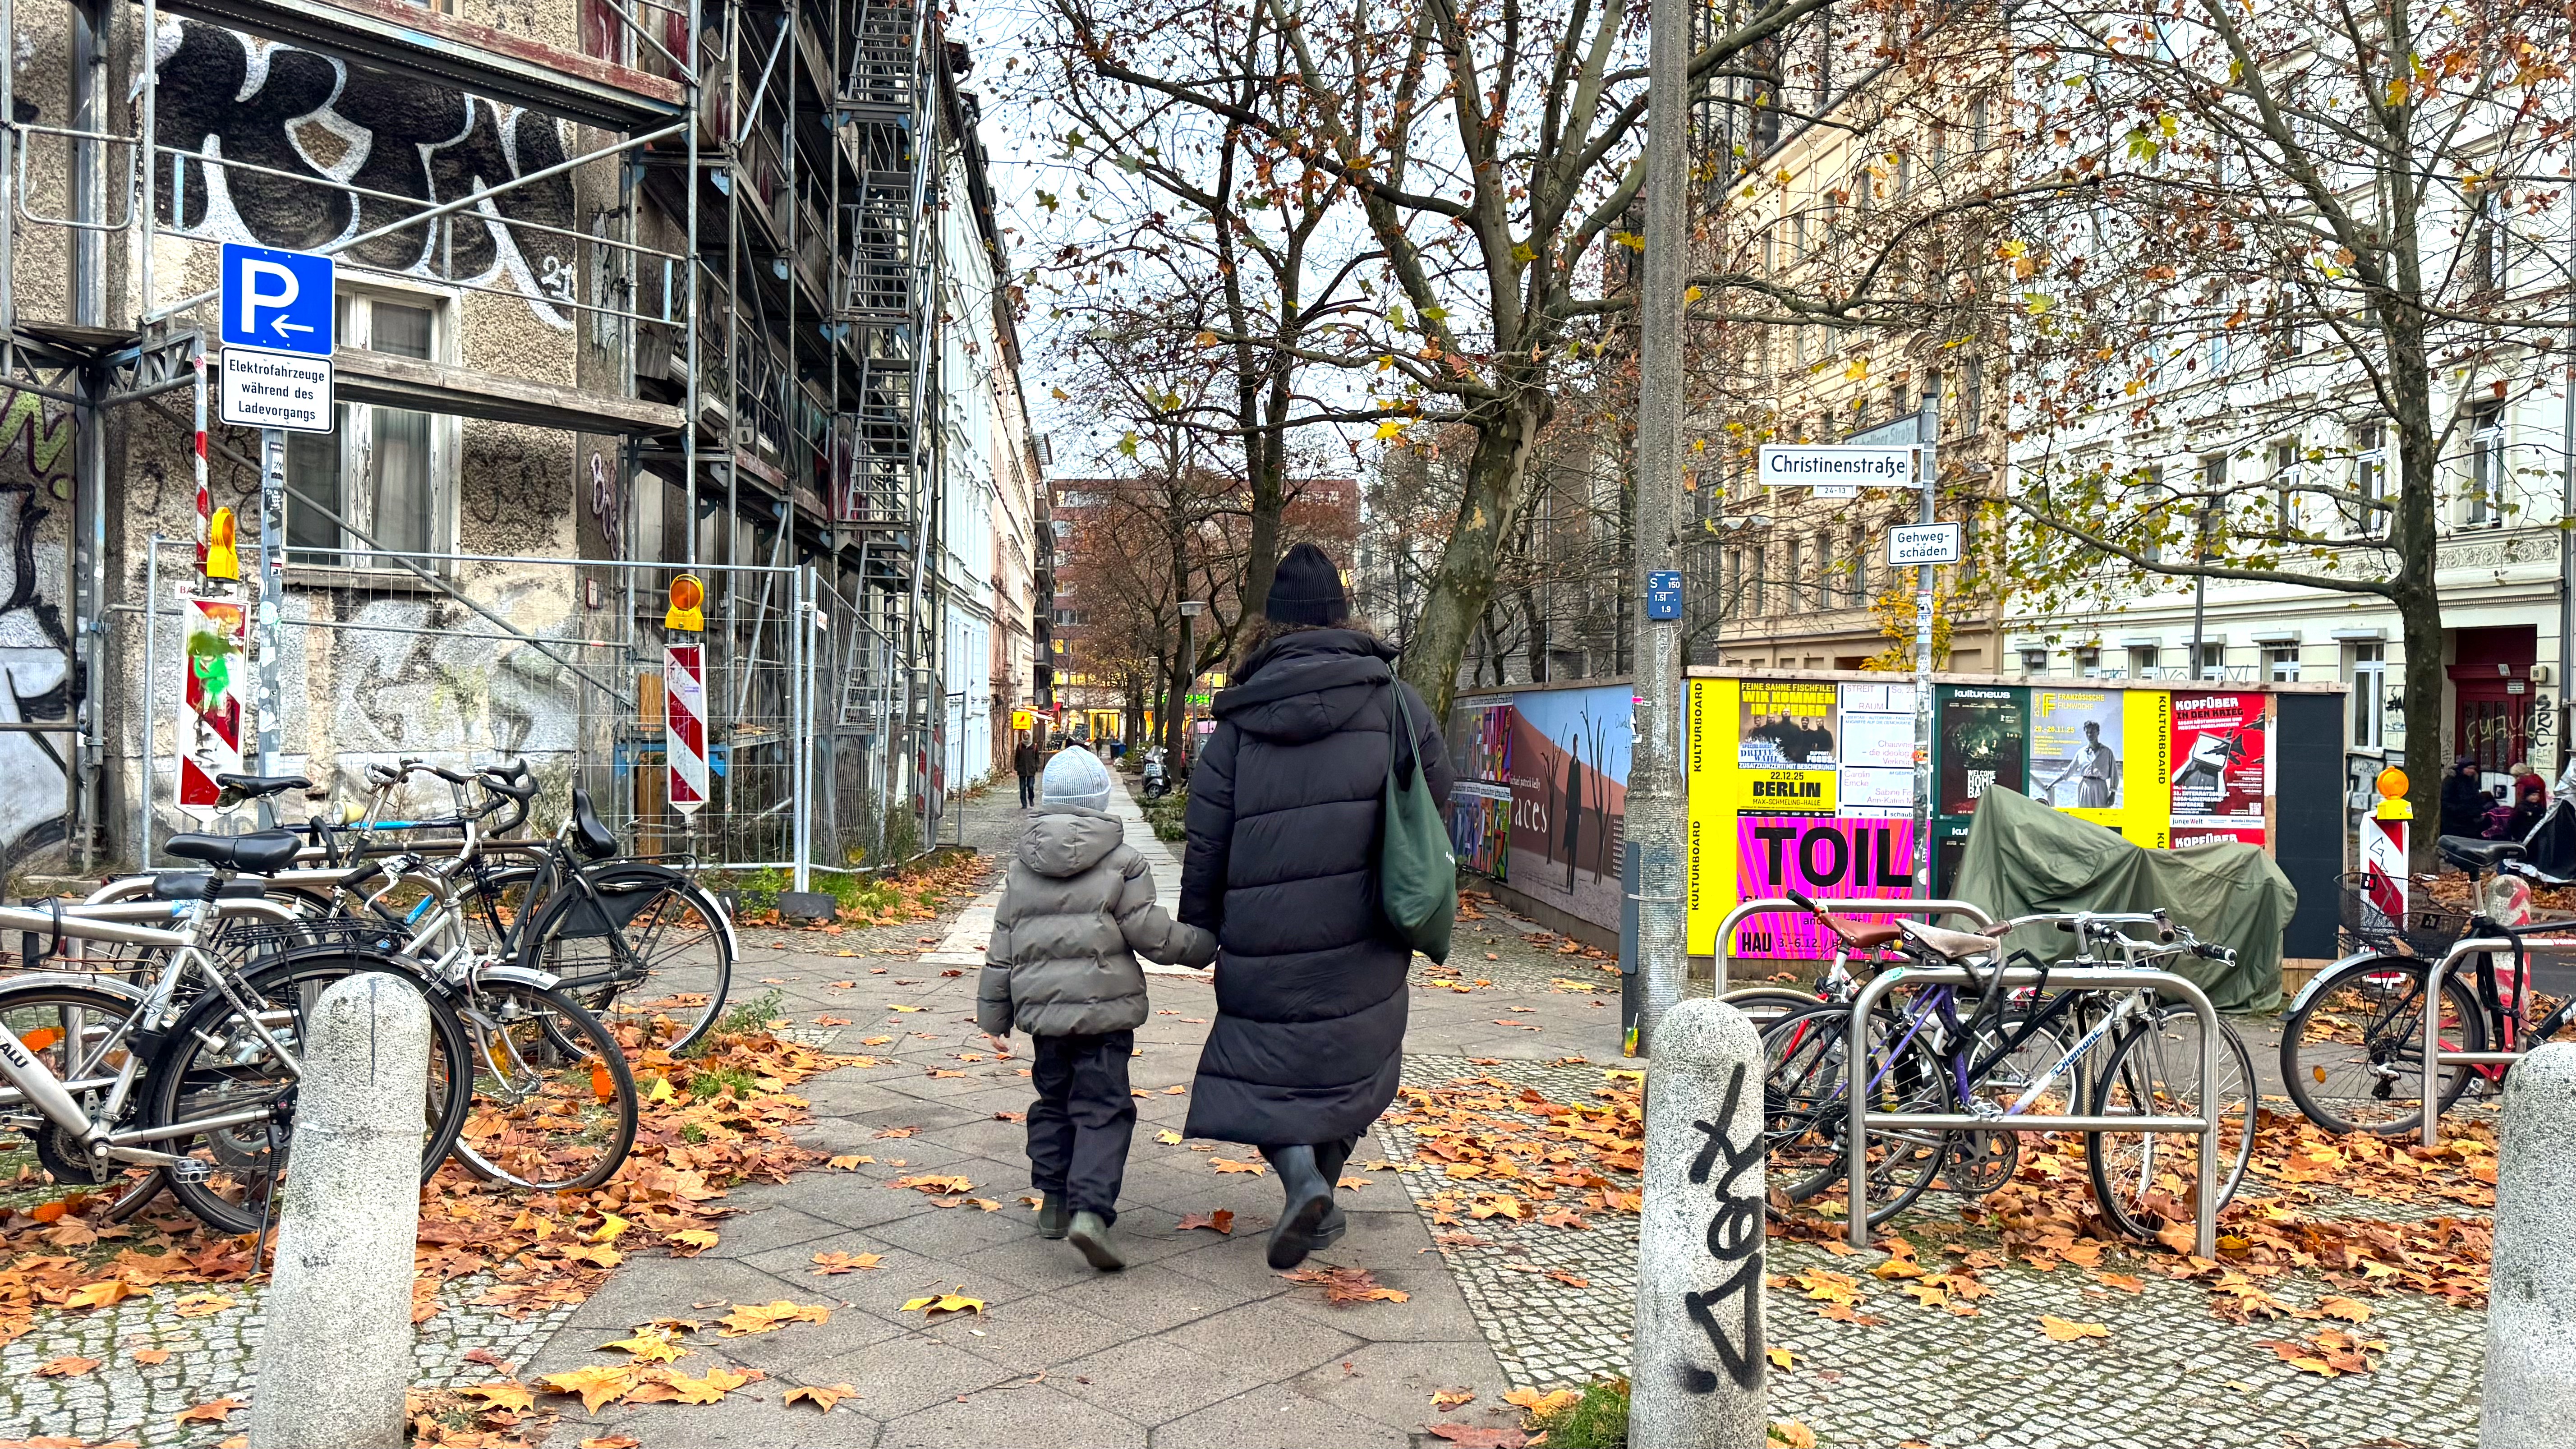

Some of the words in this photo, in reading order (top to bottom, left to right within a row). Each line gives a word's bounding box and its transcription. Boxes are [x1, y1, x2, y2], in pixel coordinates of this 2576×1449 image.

[241, 258, 299, 334] P
[229, 359, 324, 383] Elektrofahrzeuge
[242, 382, 289, 397] während
[294, 386, 313, 400] des
[239, 400, 316, 422] Ladevorgangs
[1771, 455, 1905, 478] Christinenstraße
[1897, 532, 1950, 544] Gehweg-
[1900, 544, 1948, 558] schäden
[1650, 578, 1658, 589] S
[1765, 683, 1791, 691] SAHNE
[1793, 684, 1835, 692] FISCHFILET
[1743, 691, 1769, 703] WIR
[1772, 691, 1835, 704] KOMMEN
[2057, 692, 2104, 701] FRANZÖSISCHE
[2175, 696, 2239, 711] KOPFÜBER
[1751, 704, 1766, 715] IN
[2191, 710, 2210, 718] DEN
[2212, 708, 2244, 717] KRIEG
[1694, 682, 1703, 772] KULTURBOARD
[1771, 772, 1804, 780] 22.12.25
[1968, 776, 1996, 787] HOME
[1753, 781, 1821, 797] BERLIN
[1755, 827, 1912, 887] TOIL
[1692, 820, 1701, 911] KULTURBOARD
[1742, 932, 1771, 952] HAU
